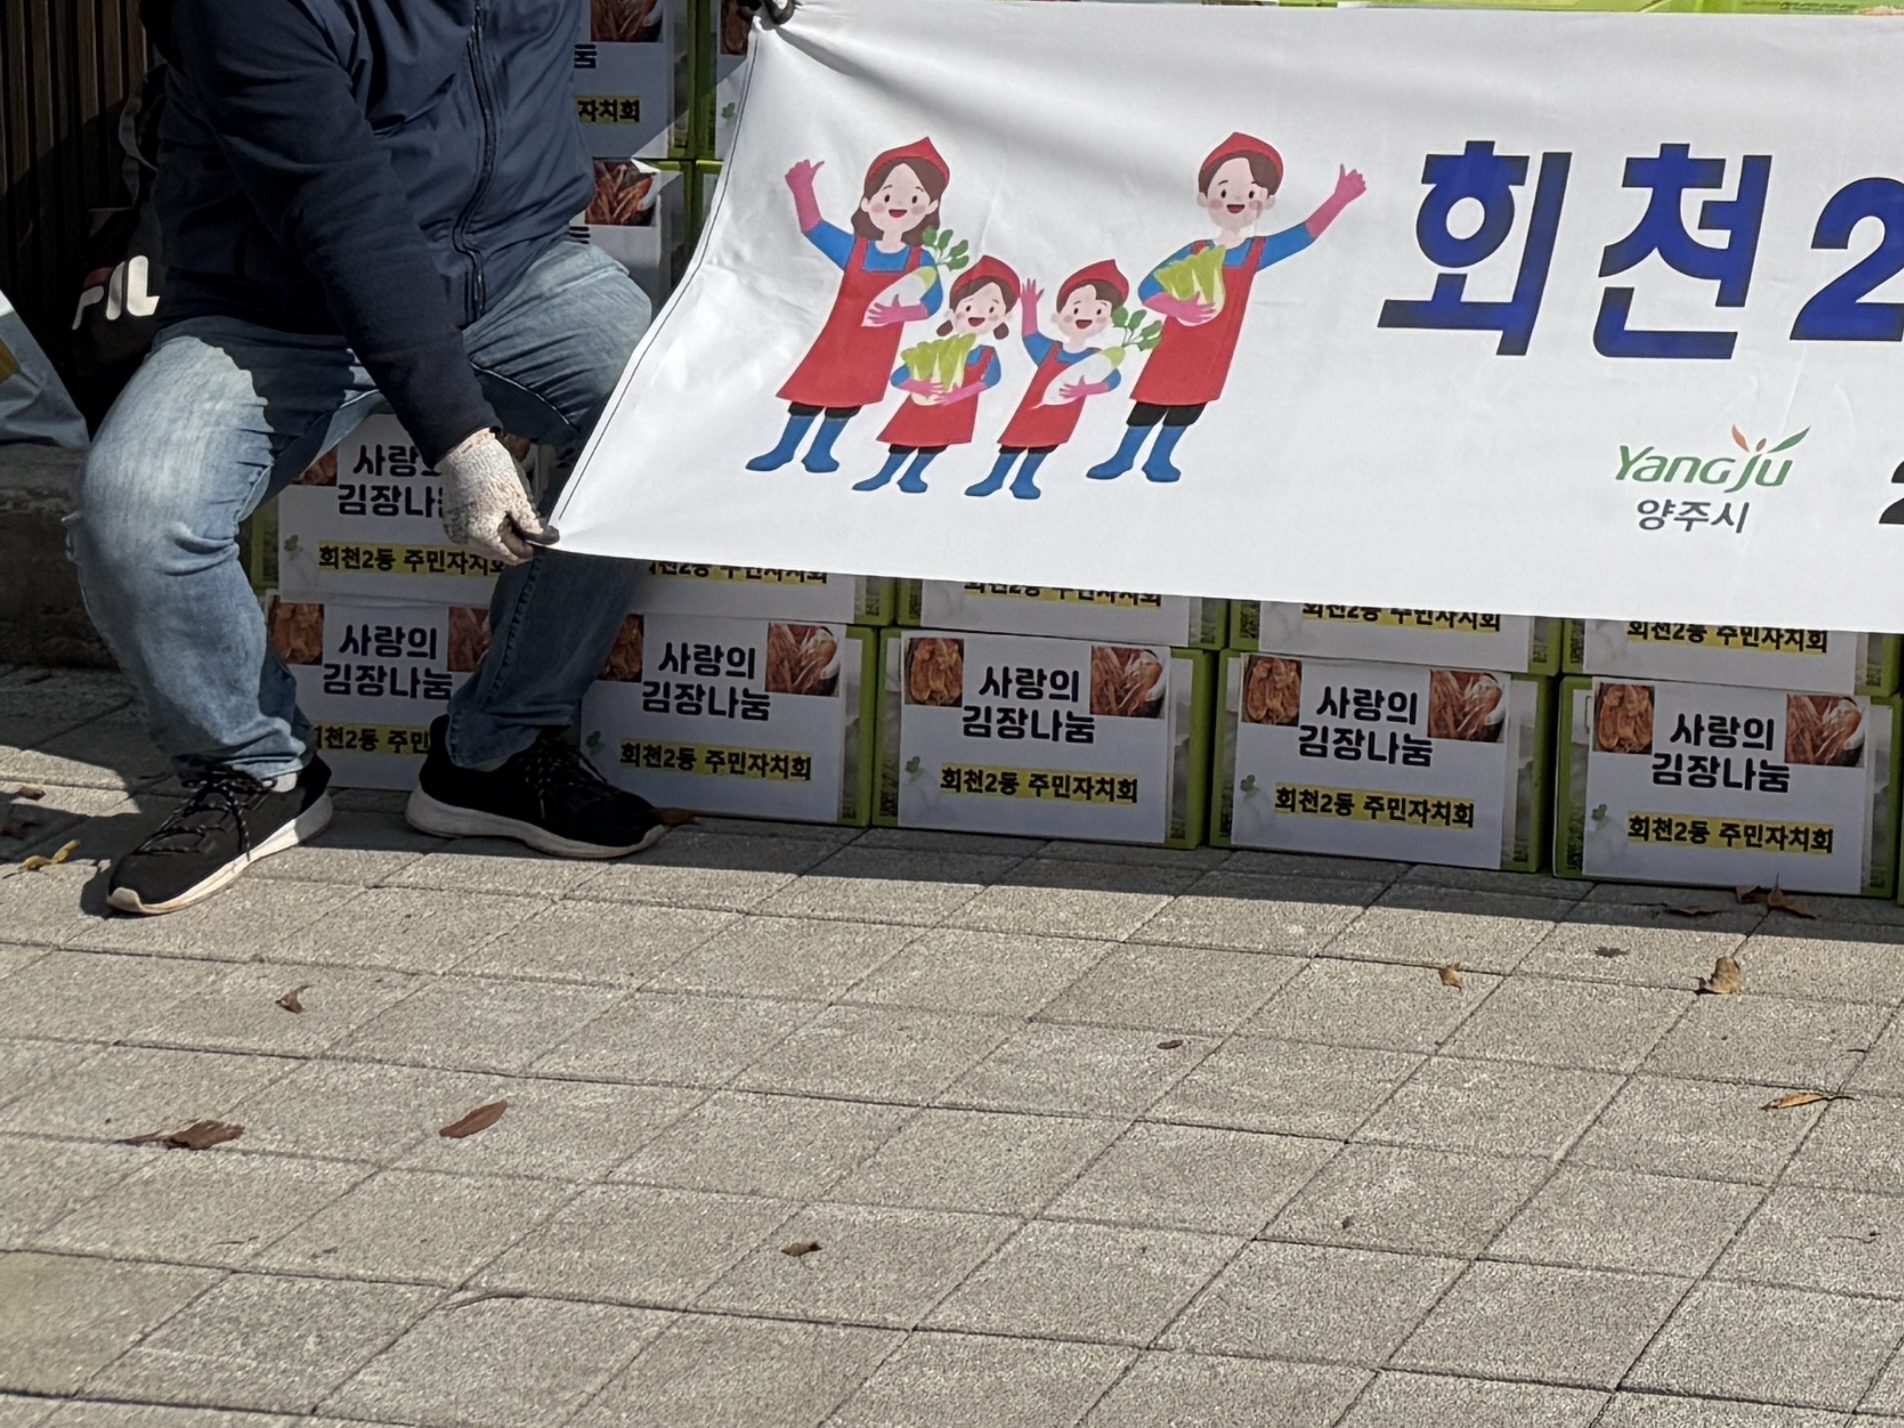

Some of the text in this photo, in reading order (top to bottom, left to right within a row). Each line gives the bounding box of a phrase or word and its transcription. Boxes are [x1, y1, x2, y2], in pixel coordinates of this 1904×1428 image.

[72, 255, 160, 331] FIL
[1638, 499, 1749, 533] 양주시
[339, 625, 436, 659] 사랑의
[658, 642, 755, 679] 사랑의
[324, 663, 453, 701] 김장나눔
[642, 680, 770, 721] 김장나눔
[979, 666, 1079, 702] 사랑의
[963, 705, 1096, 743] 김장나눔
[1670, 714, 1774, 751] 사랑의
[620, 743, 811, 780] 회천2동 주민자치회
[1652, 753, 1790, 793] 김장나눔
[940, 768, 1137, 803] 회천2동 주민자치회
[1628, 816, 1833, 854] 회천2동 주민자치회
